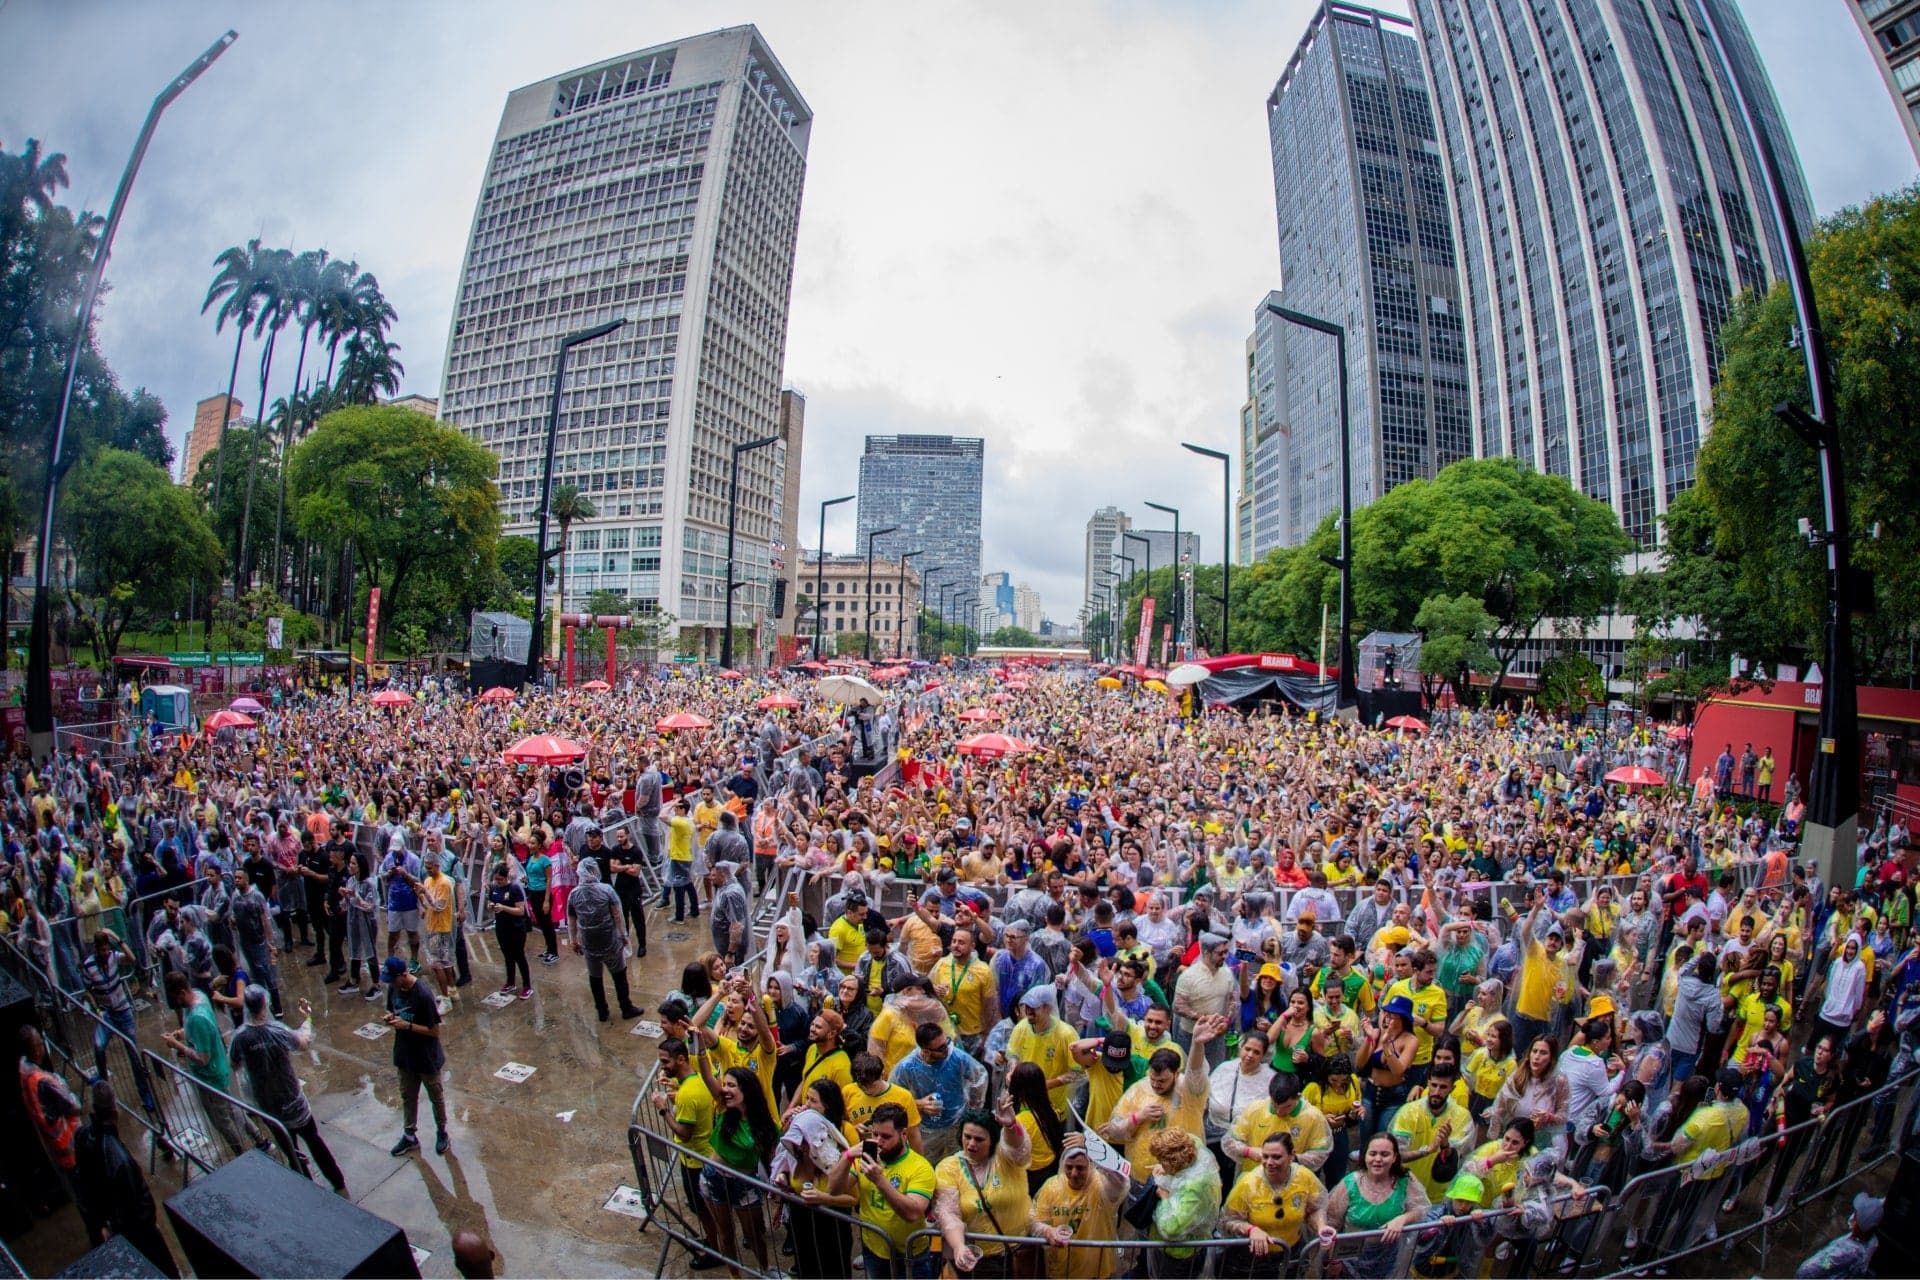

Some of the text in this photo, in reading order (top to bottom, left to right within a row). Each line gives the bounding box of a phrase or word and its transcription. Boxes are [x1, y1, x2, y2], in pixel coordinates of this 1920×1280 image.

[1261, 655, 1294, 668] BRAHMA
[1804, 688, 1823, 705] BRA
[851, 1105, 873, 1119] BRA
